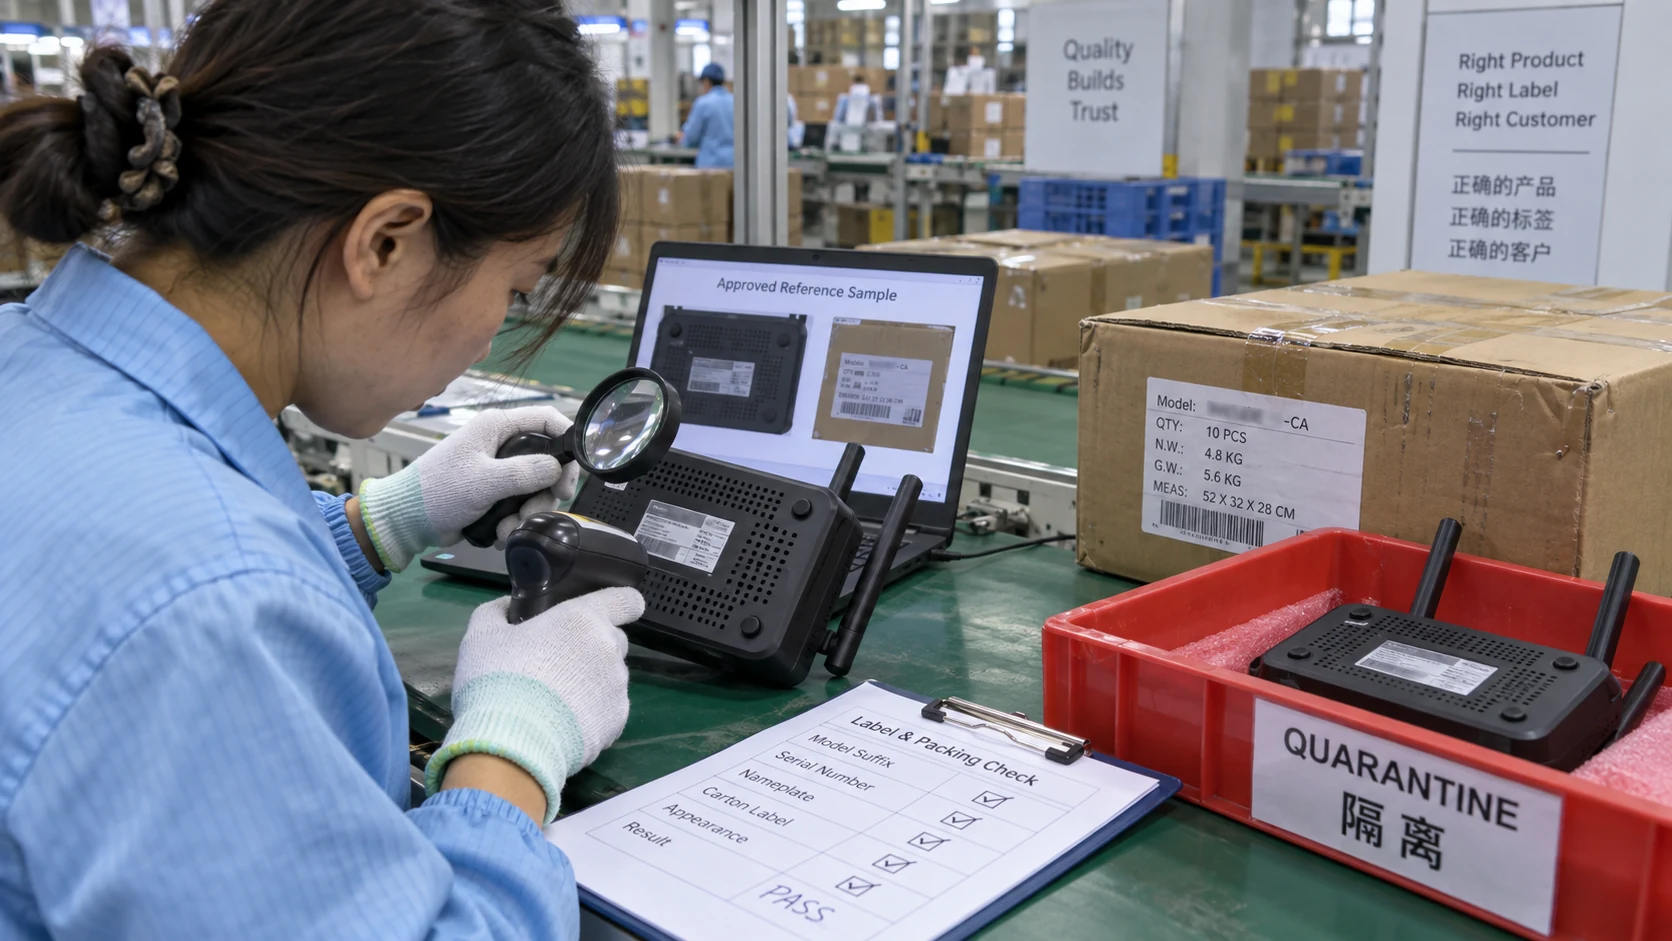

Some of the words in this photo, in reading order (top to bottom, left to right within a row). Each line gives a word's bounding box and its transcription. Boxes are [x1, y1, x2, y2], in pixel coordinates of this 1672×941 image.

[1063, 37, 1133, 64] Quality
[1459, 53, 1505, 73] Right
[1511, 50, 1584, 69] Product
[1068, 70, 1124, 92] Builds
[1457, 82, 1504, 102] Right
[1509, 80, 1558, 99] Label
[1071, 101, 1120, 122] Trust
[1455, 111, 1501, 131] Right
[1506, 110, 1597, 128] Customer
[1452, 175, 1556, 198] 正确的产品
[1449, 207, 1554, 231] 正确的标签
[1448, 239, 1552, 263] 正确的客户
[717, 277, 776, 294] Approved
[780, 281, 844, 298] Reference
[848, 286, 897, 303] Sample
[1157, 395, 1196, 412] Model:
[1284, 416, 1309, 431] -CA
[1156, 417, 1183, 432] QTY:
[1206, 426, 1220, 439] 10
[1224, 429, 1247, 444] PCS
[1155, 439, 1183, 454] N.W.:
[1205, 448, 1222, 461] 4.8
[1226, 451, 1242, 465] KG
[1155, 460, 1183, 476] G.W.:
[1204, 469, 1221, 482] 5.6
[1225, 473, 1241, 487] KG
[1153, 480, 1187, 498] MEAS:
[1203, 491, 1216, 503] 52
[1219, 494, 1227, 505] X
[1230, 496, 1243, 508] 32
[1247, 500, 1254, 511] X
[1257, 501, 1271, 514] 28
[1276, 505, 1295, 519] CM
[808, 734, 854, 756] Model
[854, 748, 895, 769] Suffix
[850, 716, 899, 738] Label
[898, 732, 913, 742] &
[914, 736, 982, 768] Packing
[984, 759, 1040, 787] Check
[775, 750, 816, 770] Serial
[816, 765, 874, 792] Number
[1284, 727, 1520, 831] QUARANTINE
[739, 768, 815, 804] Nameplate
[702, 786, 751, 810] Carton
[748, 805, 794, 827] Label
[622, 820, 672, 848] Result
[662, 802, 749, 845] Appearance
[1341, 792, 1445, 871] 隔离
[759, 884, 835, 924] PASS
